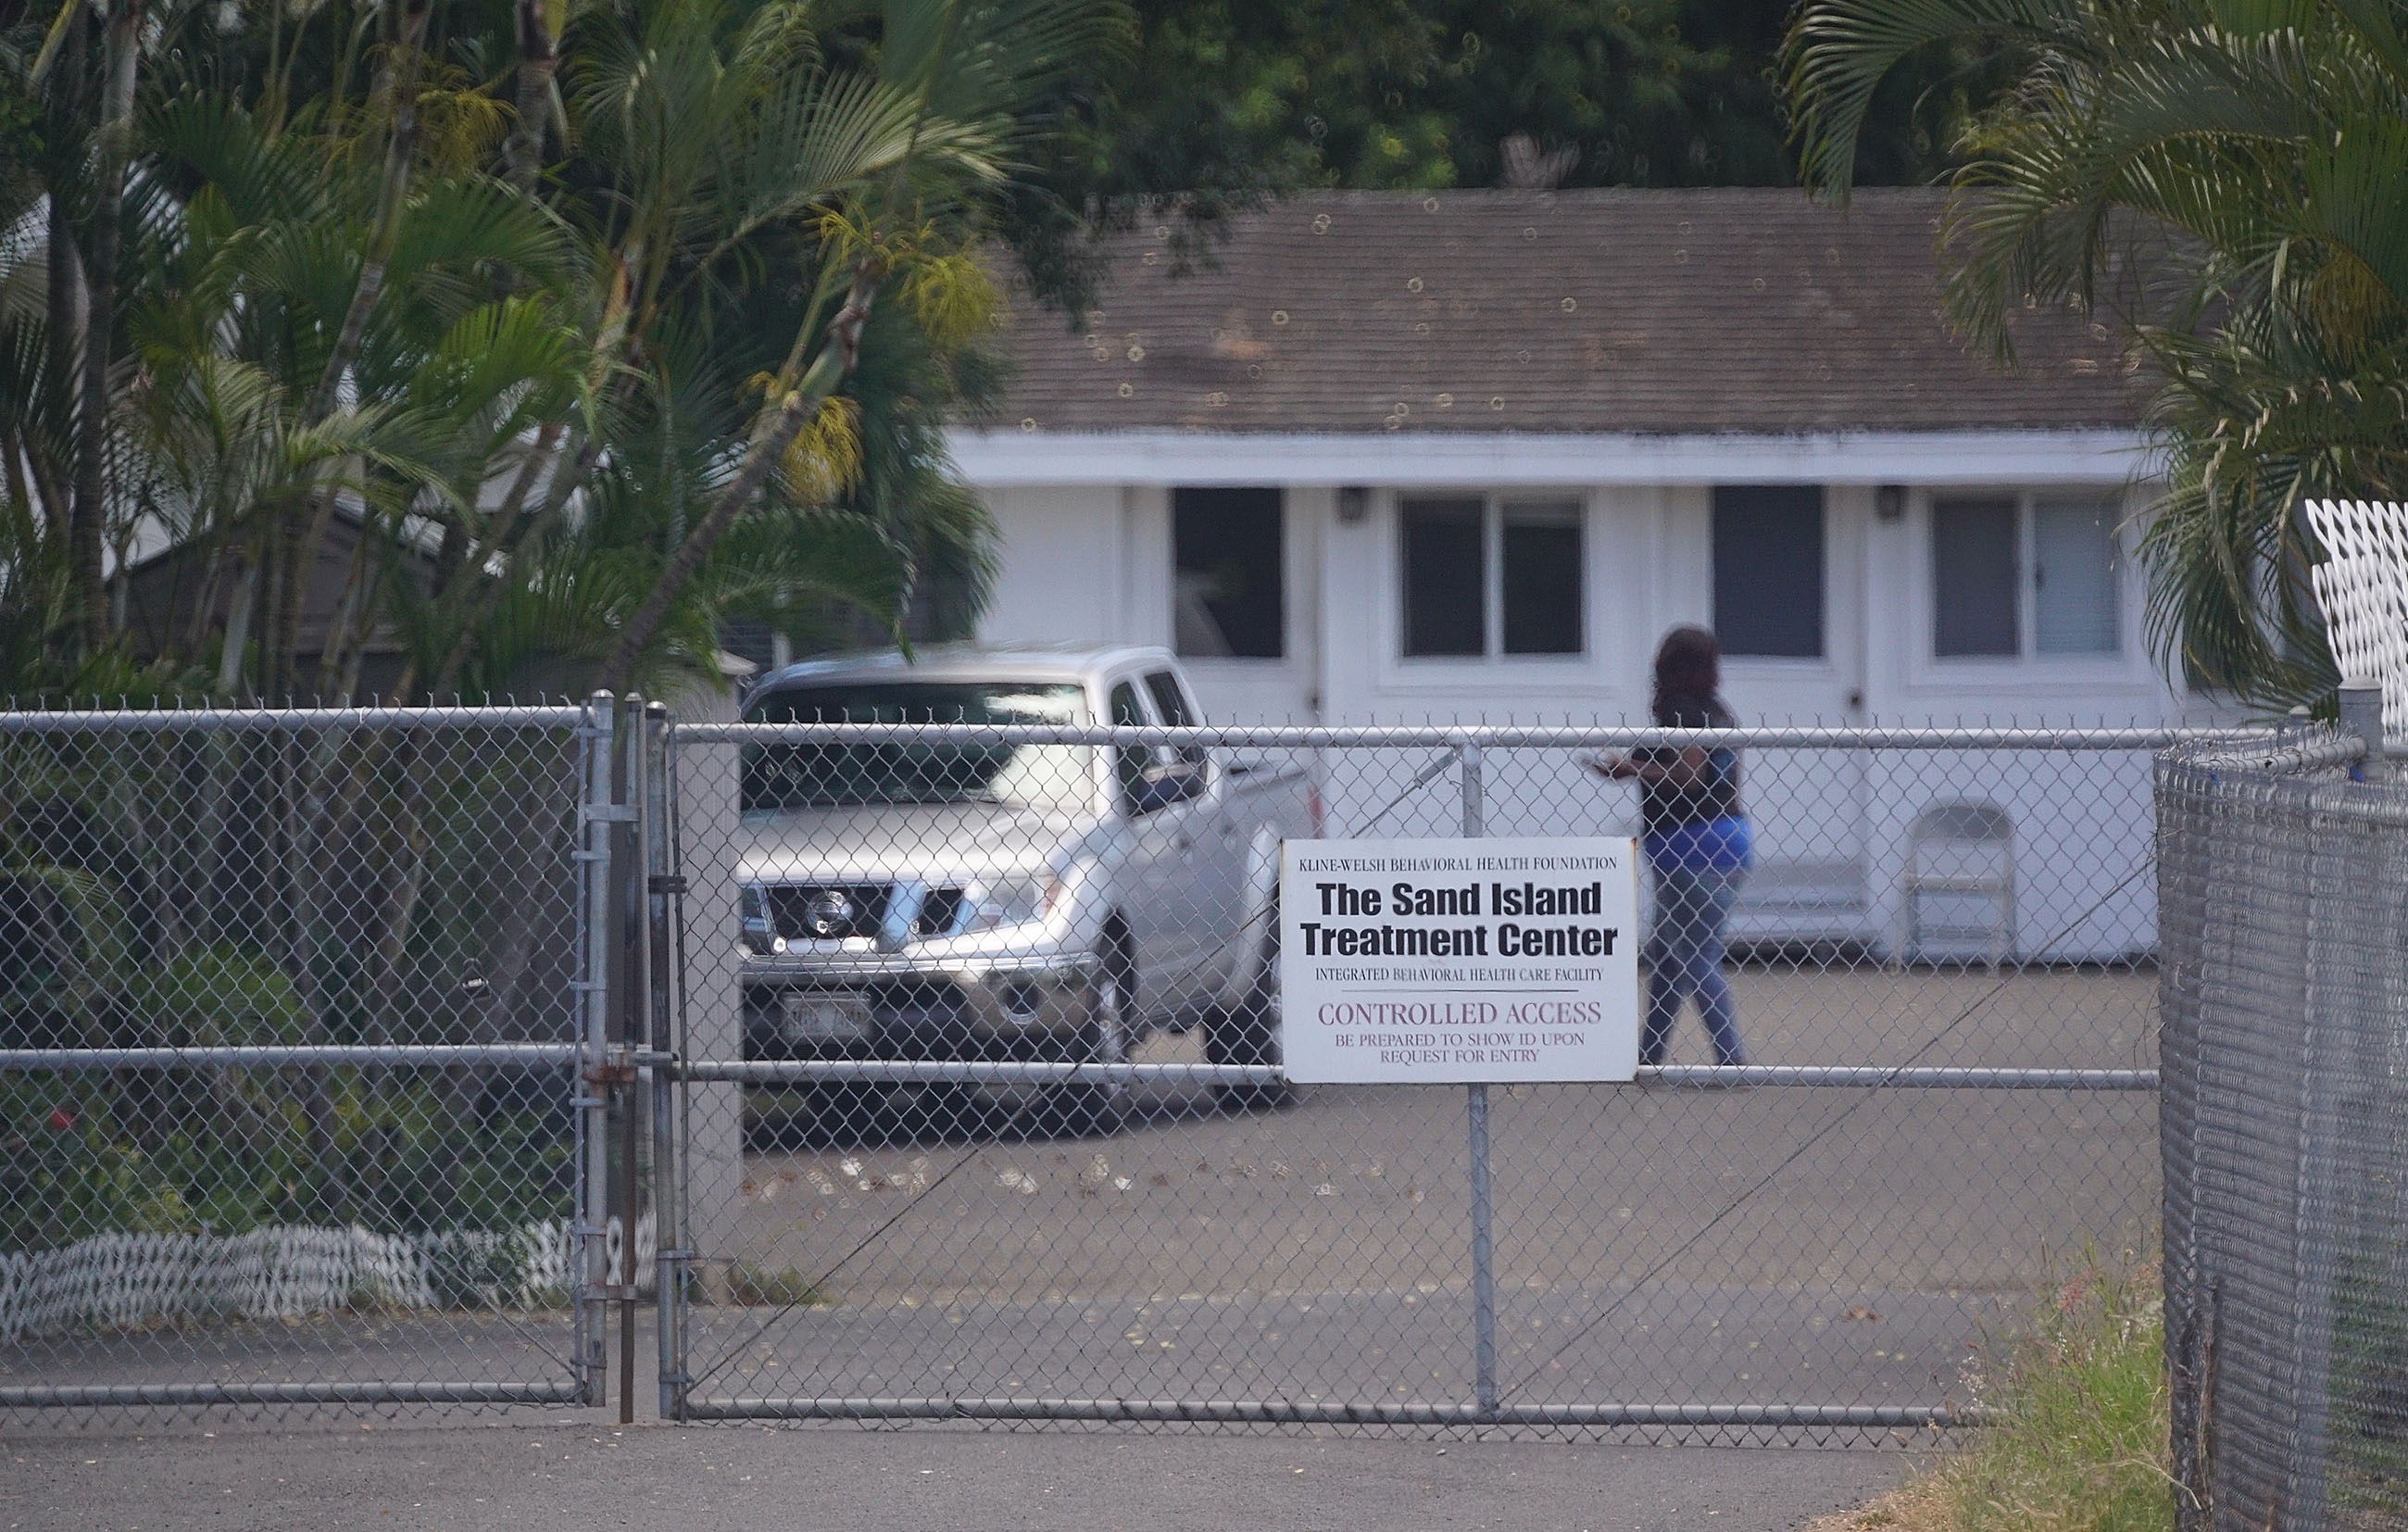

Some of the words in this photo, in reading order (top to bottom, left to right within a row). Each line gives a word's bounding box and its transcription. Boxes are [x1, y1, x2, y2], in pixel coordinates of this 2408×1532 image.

[1299, 859, 1386, 872] KLINE-WELSH
[1391, 858, 1473, 872] BEHAVIORAL
[1477, 857, 1529, 871] HEALTH
[1534, 857, 1617, 871] FOUNDATION
[1316, 883, 1382, 916] The
[1392, 882, 1480, 916] Sand
[1492, 882, 1601, 915] Island
[1300, 923, 1488, 956] Treatment
[1498, 923, 1618, 957] Center
[1316, 968, 1389, 981] INTEGRATED
[1393, 968, 1465, 981] BEHAVIORAL
[1470, 968, 1515, 981] HEALTH
[1520, 968, 1551, 981] CARE
[1554, 968, 1604, 981] FACILITY
[1318, 1002, 1497, 1025] CONTROLLED
[1505, 1001, 1601, 1024] ACCESS
[1336, 1034, 1354, 1047] BE
[1360, 1034, 1436, 1047] PREPARED
[1440, 1033, 1463, 1047] TO
[1468, 1033, 1515, 1046] SHOW
[1520, 1033, 1536, 1046] ID
[1541, 1033, 1585, 1046] UPON
[1380, 1049, 1449, 1065] REQUEST
[1455, 1049, 1486, 1062] FOR
[1490, 1049, 1540, 1062] ENTRY
